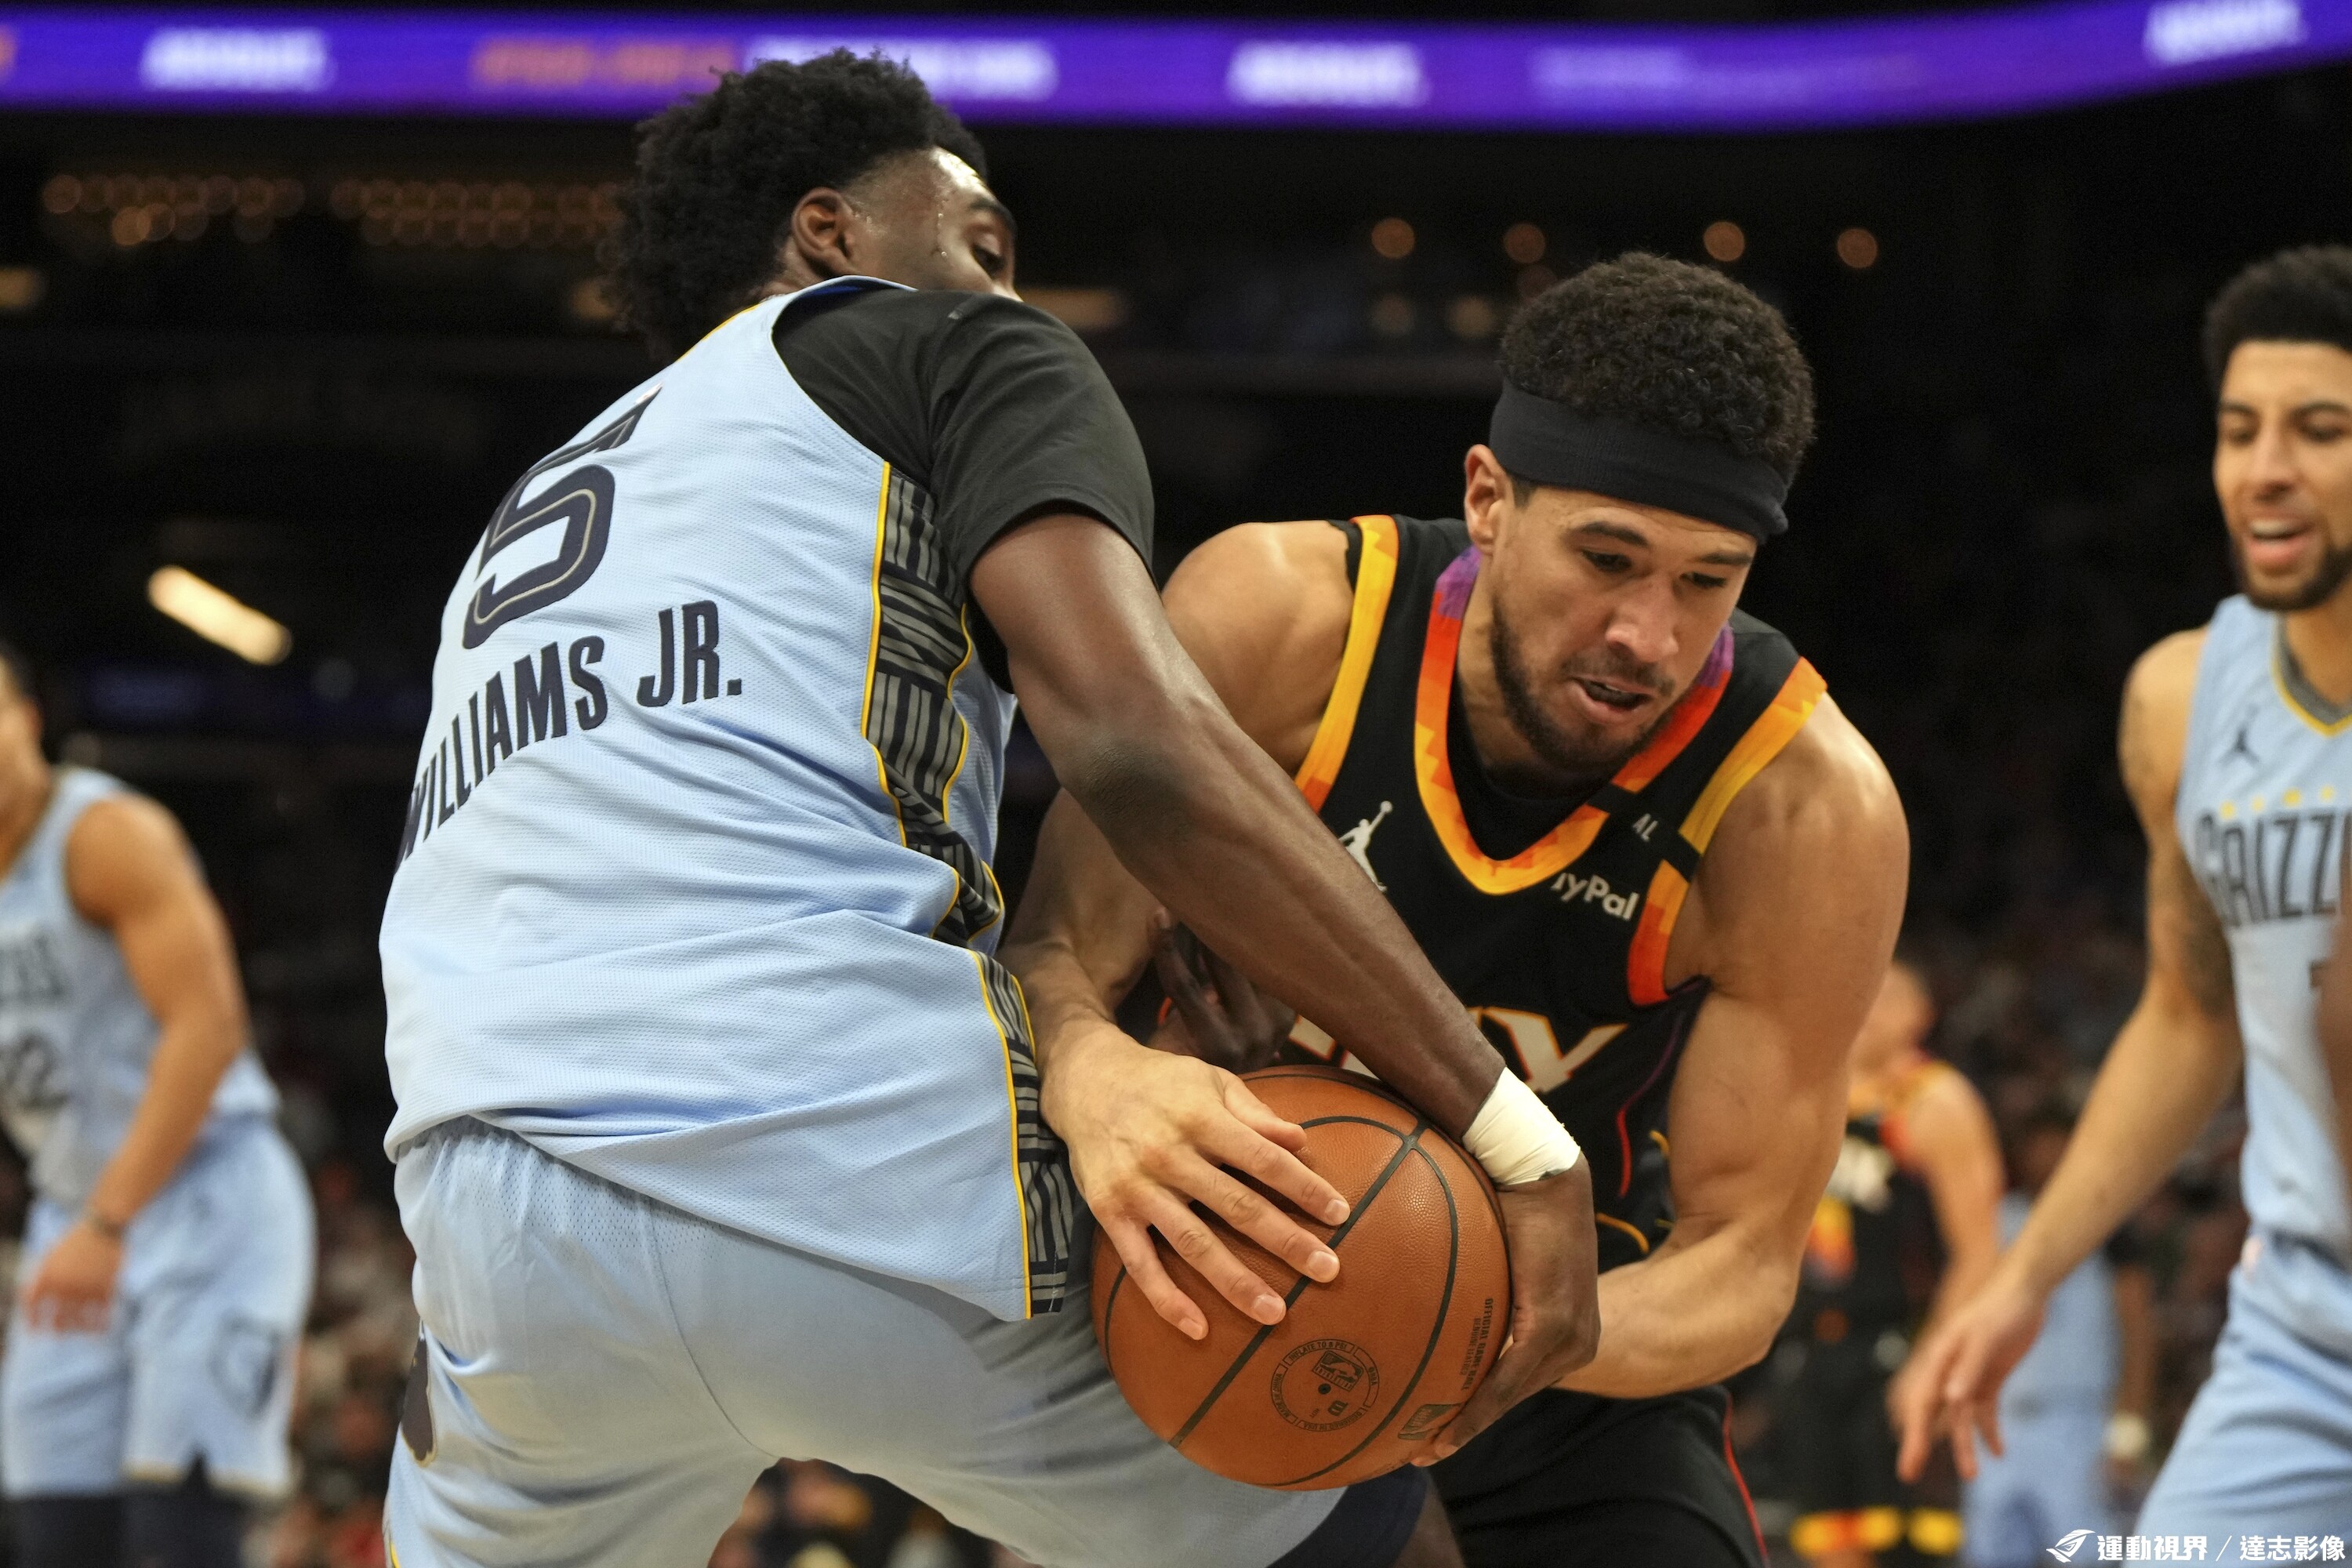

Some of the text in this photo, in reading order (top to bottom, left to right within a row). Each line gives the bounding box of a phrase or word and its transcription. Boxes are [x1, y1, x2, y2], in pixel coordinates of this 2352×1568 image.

[462, 387, 662, 650] 5
[636, 600, 742, 708] JR.
[1551, 873, 1640, 921] yPal
[1480, 1298, 1494, 1339] OFFICIAL
[1288, 1344, 1316, 1362] INFLATE
